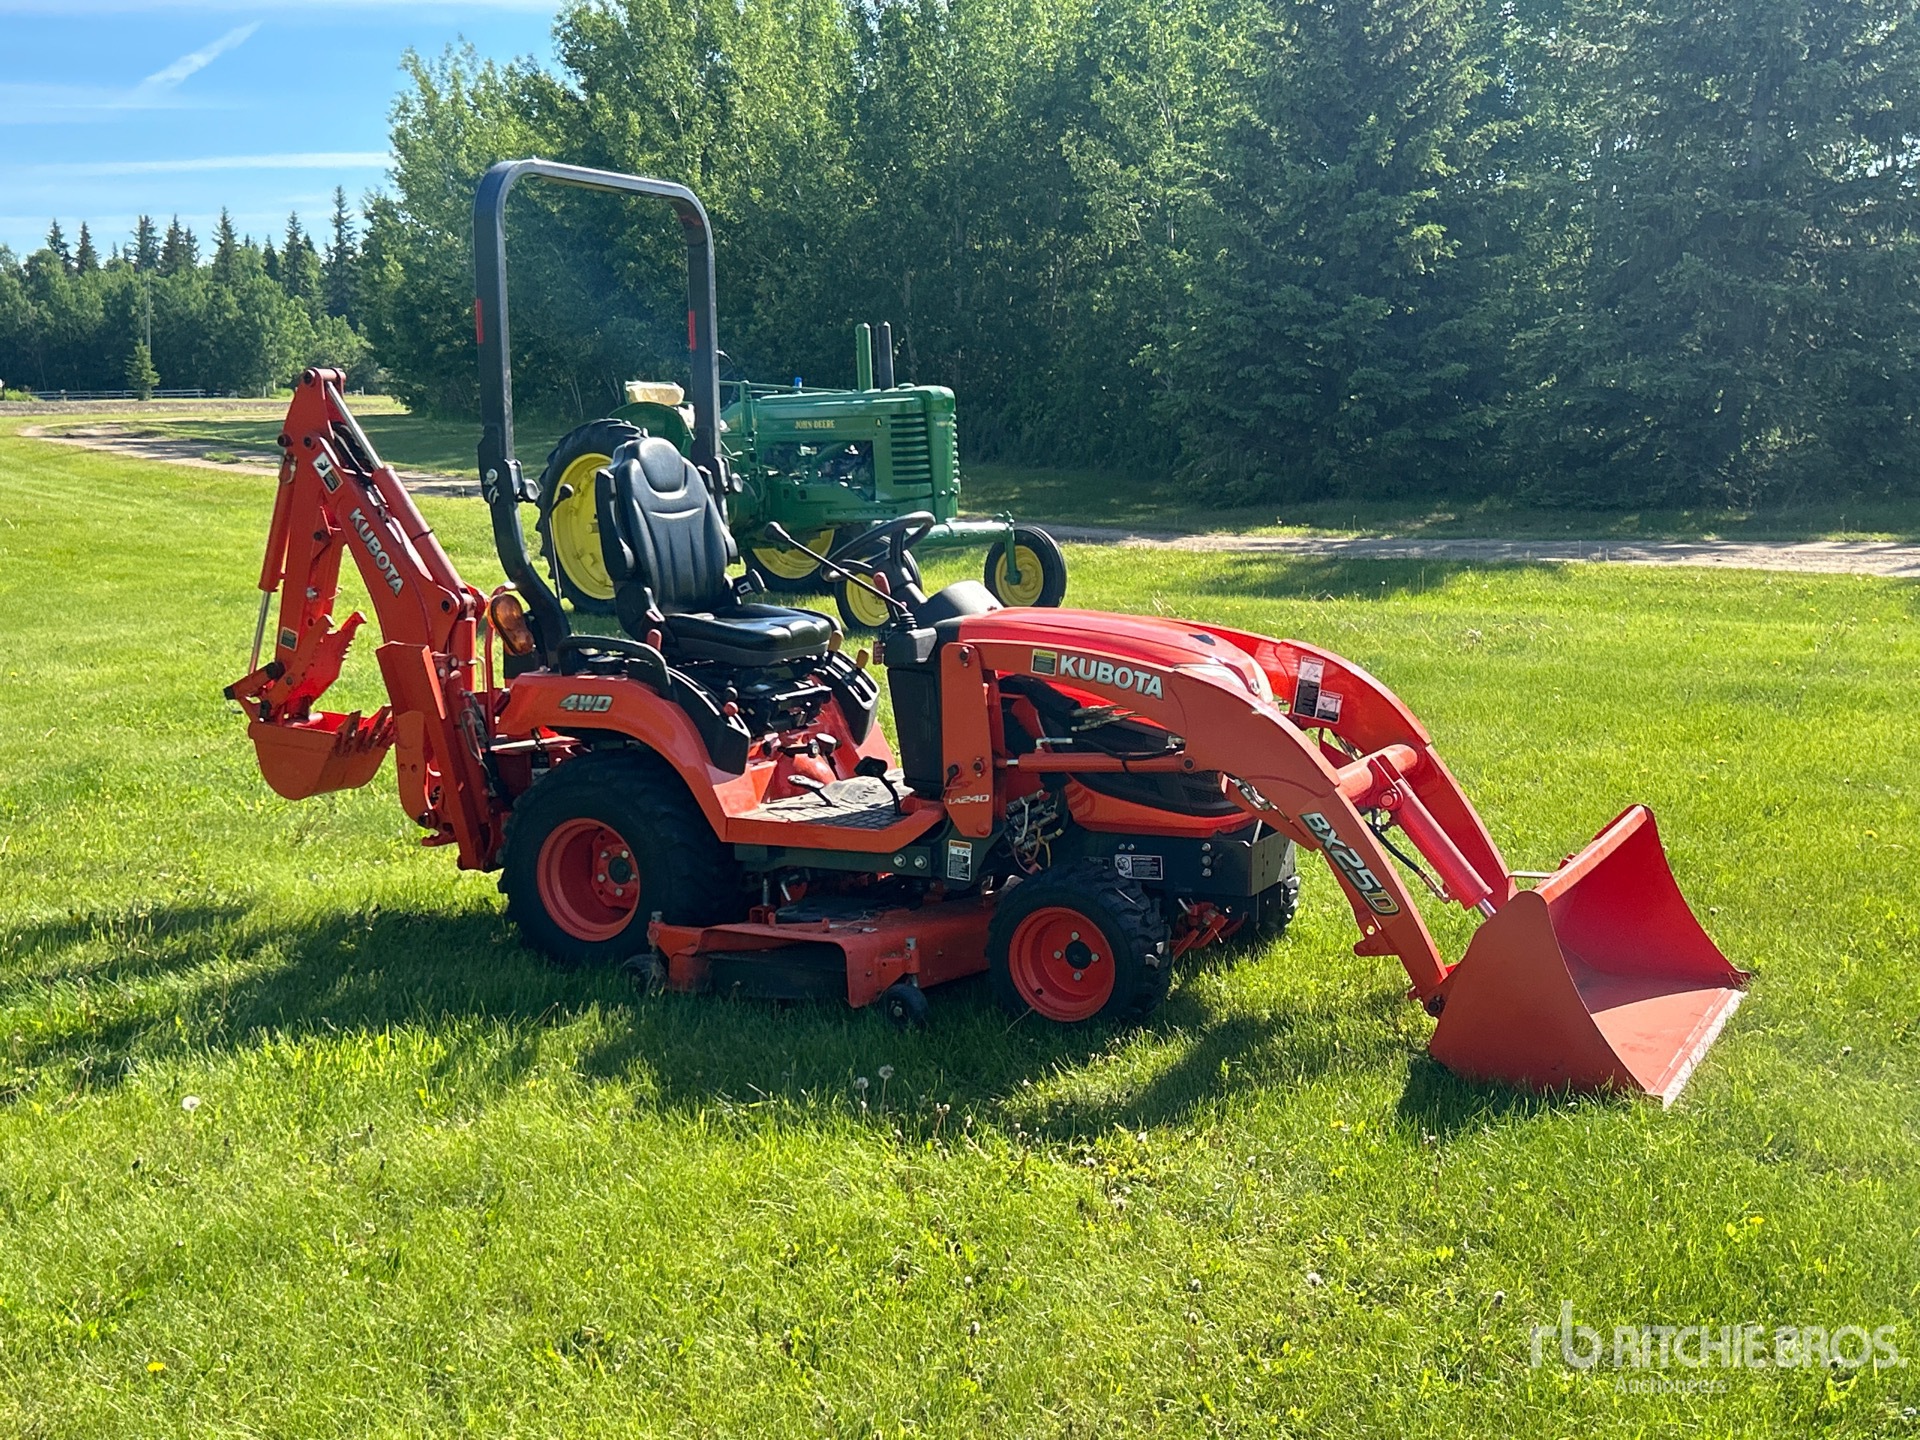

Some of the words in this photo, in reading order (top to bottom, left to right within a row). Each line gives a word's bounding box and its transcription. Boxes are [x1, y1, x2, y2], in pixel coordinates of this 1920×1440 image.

[813, 419, 836, 429] DEERE
[350, 507, 404, 597] KUBOTA
[1059, 654, 1164, 699] KUBOTA
[558, 693, 614, 712] 4WD
[948, 794, 990, 805] LA240
[1300, 812, 1400, 914] BX25D
